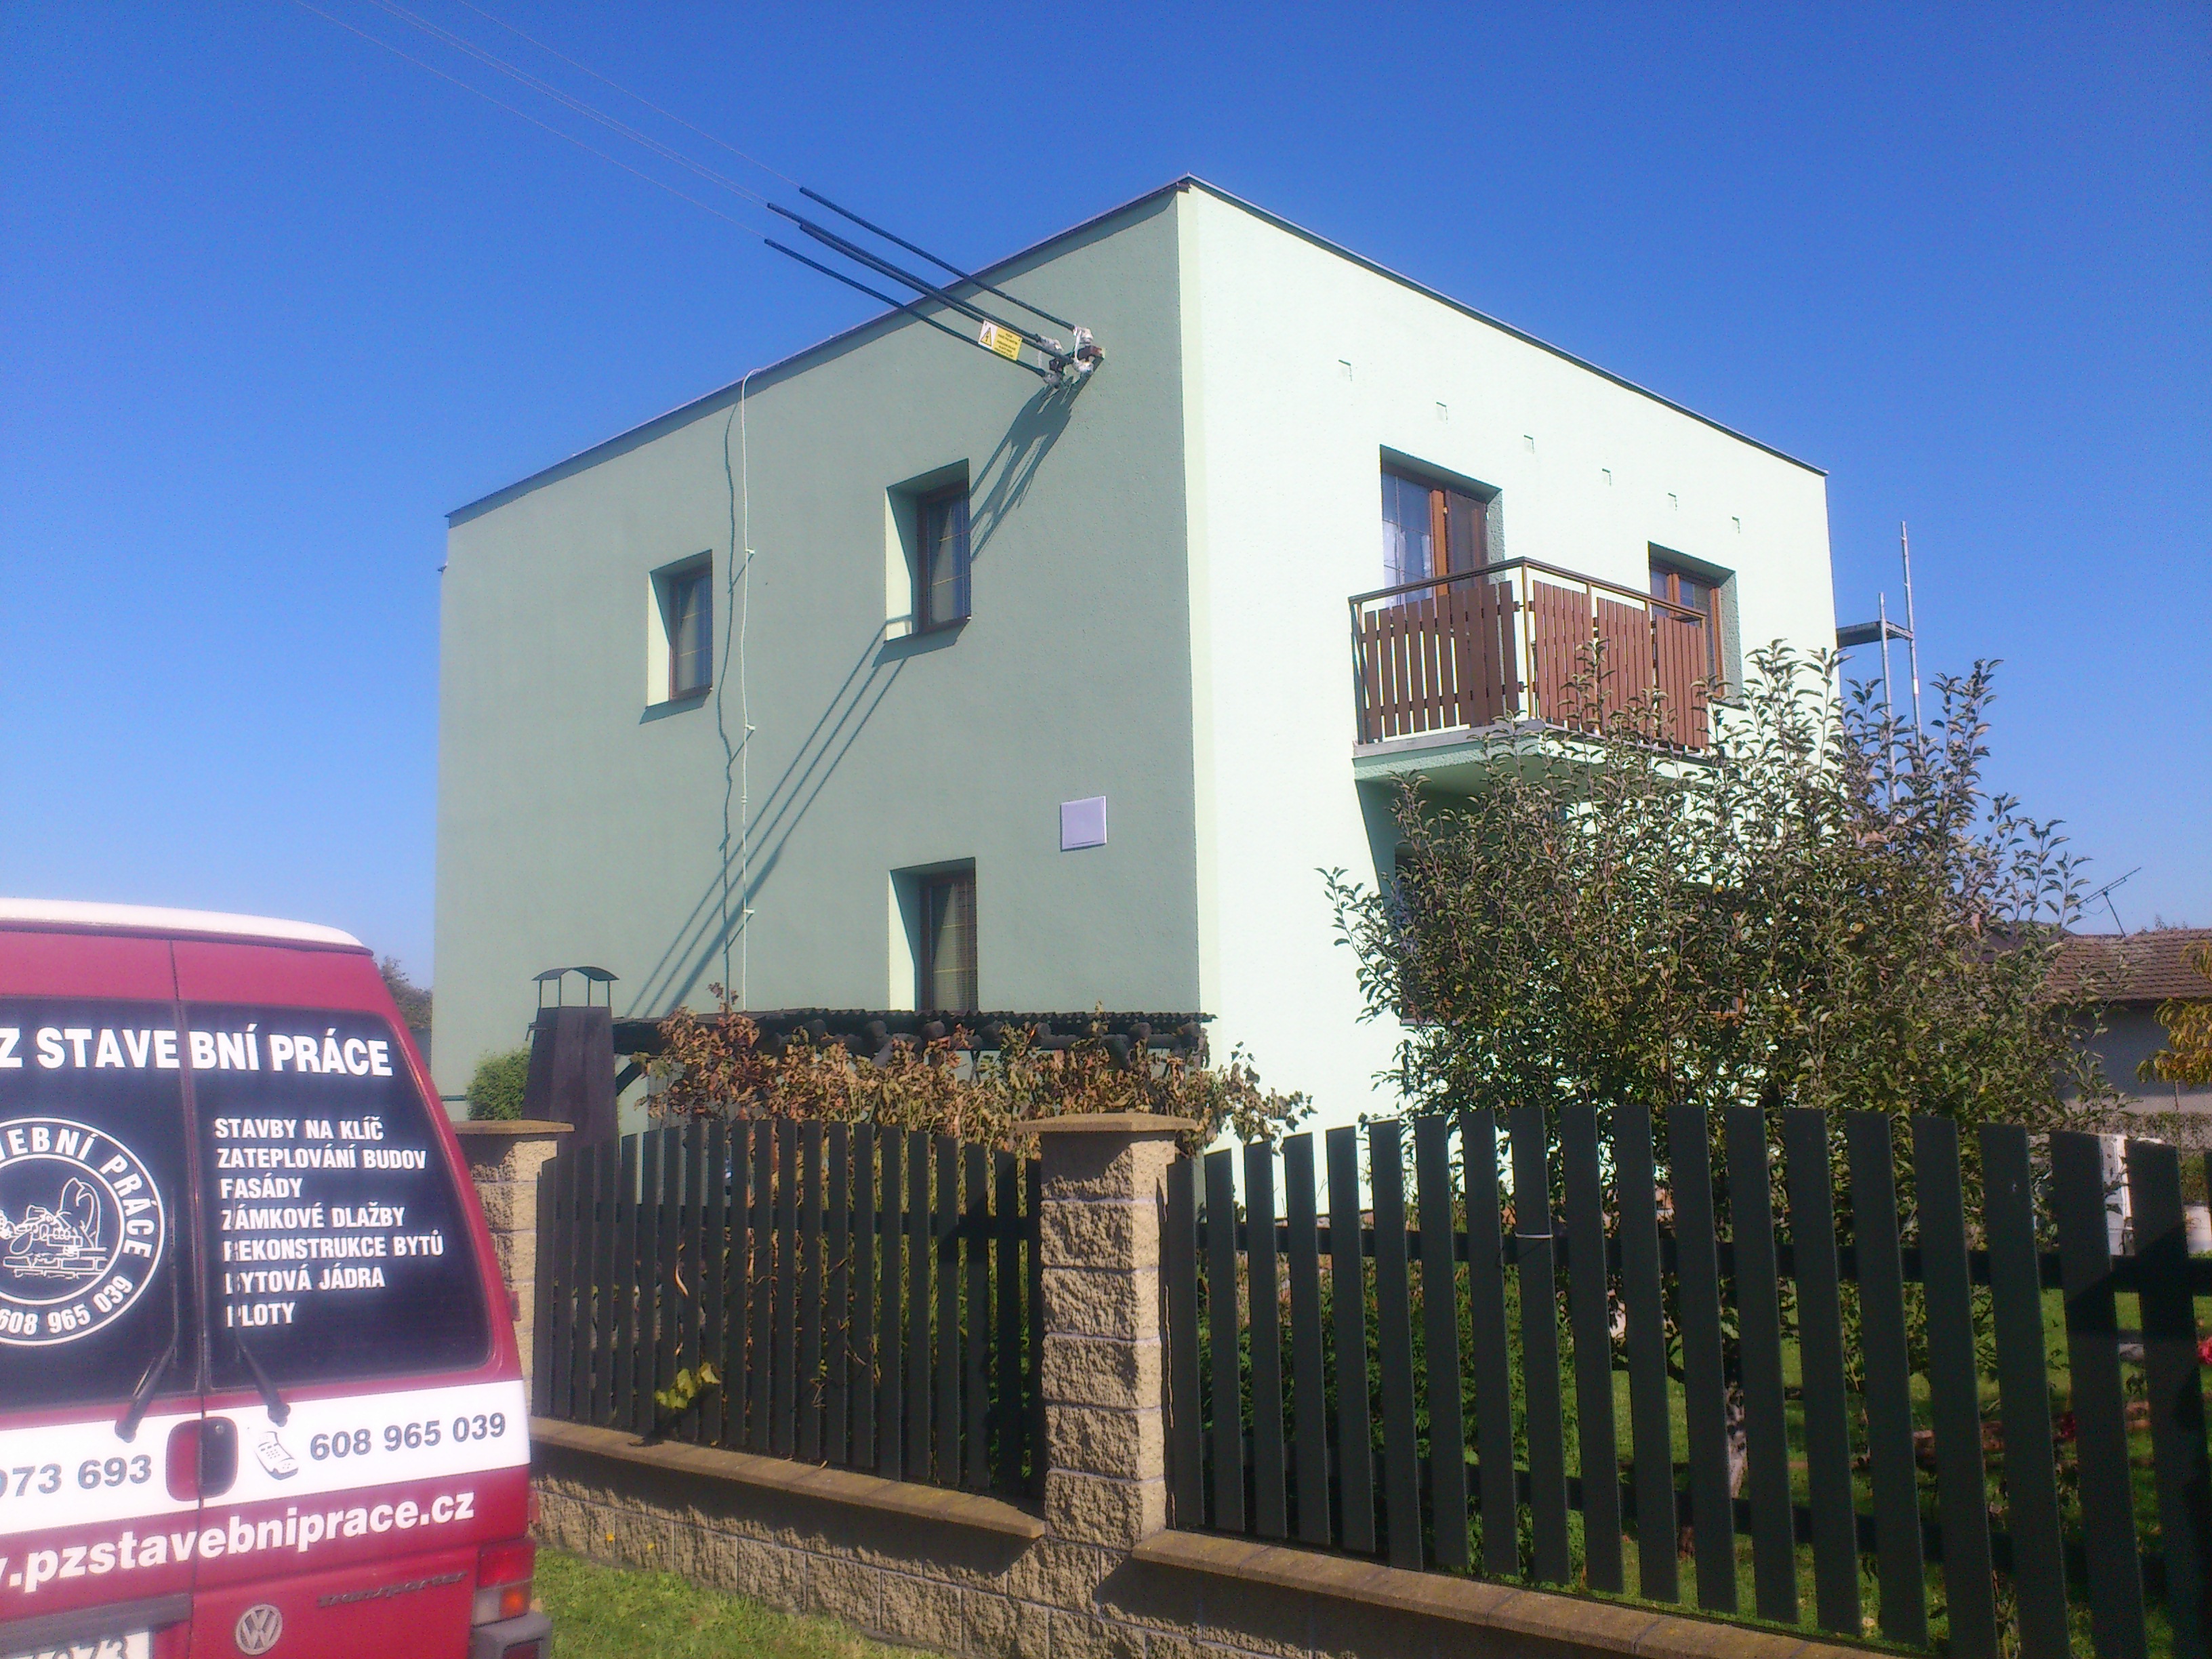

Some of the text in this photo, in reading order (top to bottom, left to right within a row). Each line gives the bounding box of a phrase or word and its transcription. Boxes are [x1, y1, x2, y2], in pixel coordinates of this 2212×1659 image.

[36, 1024, 260, 1071] STAVEBNÍ
[268, 1028, 393, 1076] PRÁCE
[215, 1116, 384, 1141] STAVBY NA KLÍČ
[217, 1143, 427, 1170] ZATEPLOVÁNÍ BUDOV
[0, 1127, 158, 1258] EBNÍ PRÁCE
[220, 1172, 303, 1199] FASÁDY
[221, 1202, 405, 1231] ZÁMKOVÉ DLAŽBY
[394, 1229, 445, 1256] BYTŮ
[319, 1263, 386, 1291] JÁDRA
[47, 1304, 91, 1334] 965
[93, 1275, 134, 1313] 039
[310, 1412, 507, 1460] 608 965 039
[78, 1454, 152, 1490] 693
